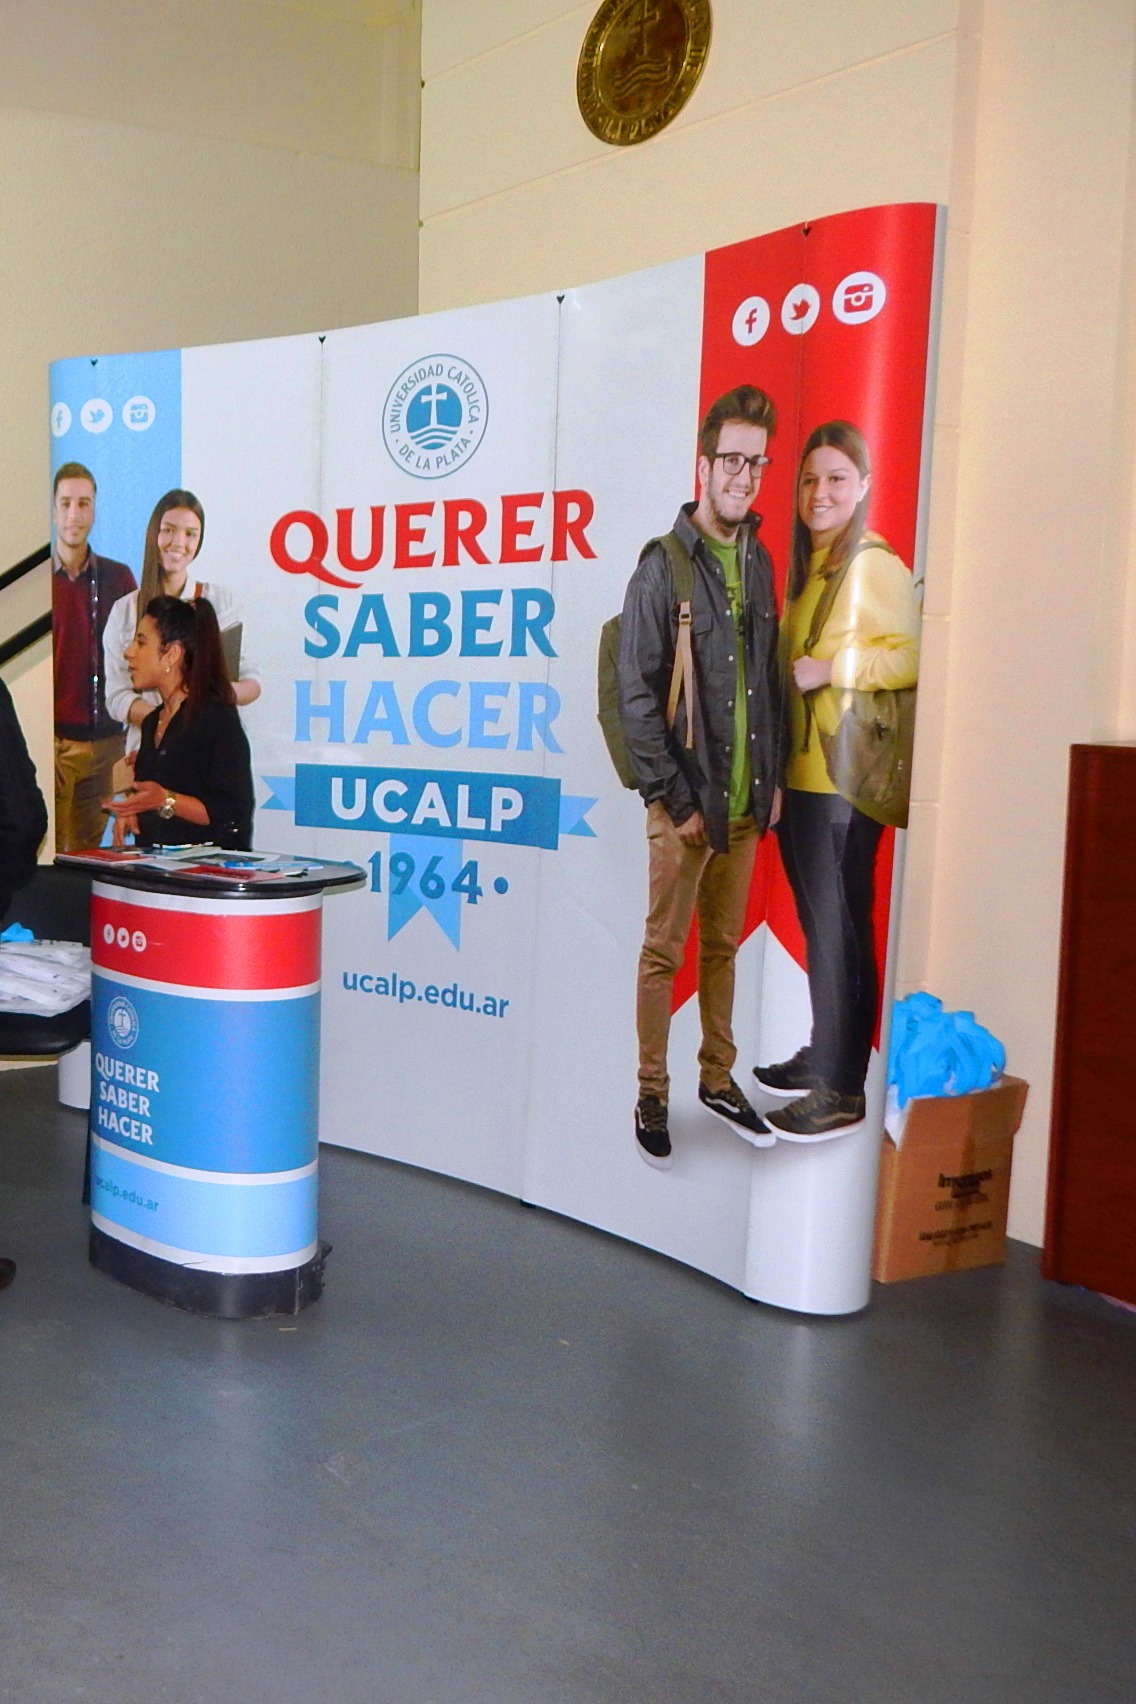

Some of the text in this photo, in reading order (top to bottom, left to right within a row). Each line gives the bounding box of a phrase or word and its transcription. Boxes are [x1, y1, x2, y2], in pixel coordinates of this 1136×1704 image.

[389, 363, 481, 471] UNIVERSIDAD CATOLICA DE LA PLATA
[269, 488, 598, 589] QUERER
[303, 587, 559, 659] SABER
[293, 679, 565, 754] HACER
[330, 777, 524, 832] UCALP
[366, 850, 484, 905] 1964
[342, 970, 510, 1019] ucalp.edu.ar
[95, 1052, 160, 1093] QUERER
[99, 1080, 151, 1118] SABER
[97, 1105, 154, 1146] HACER
